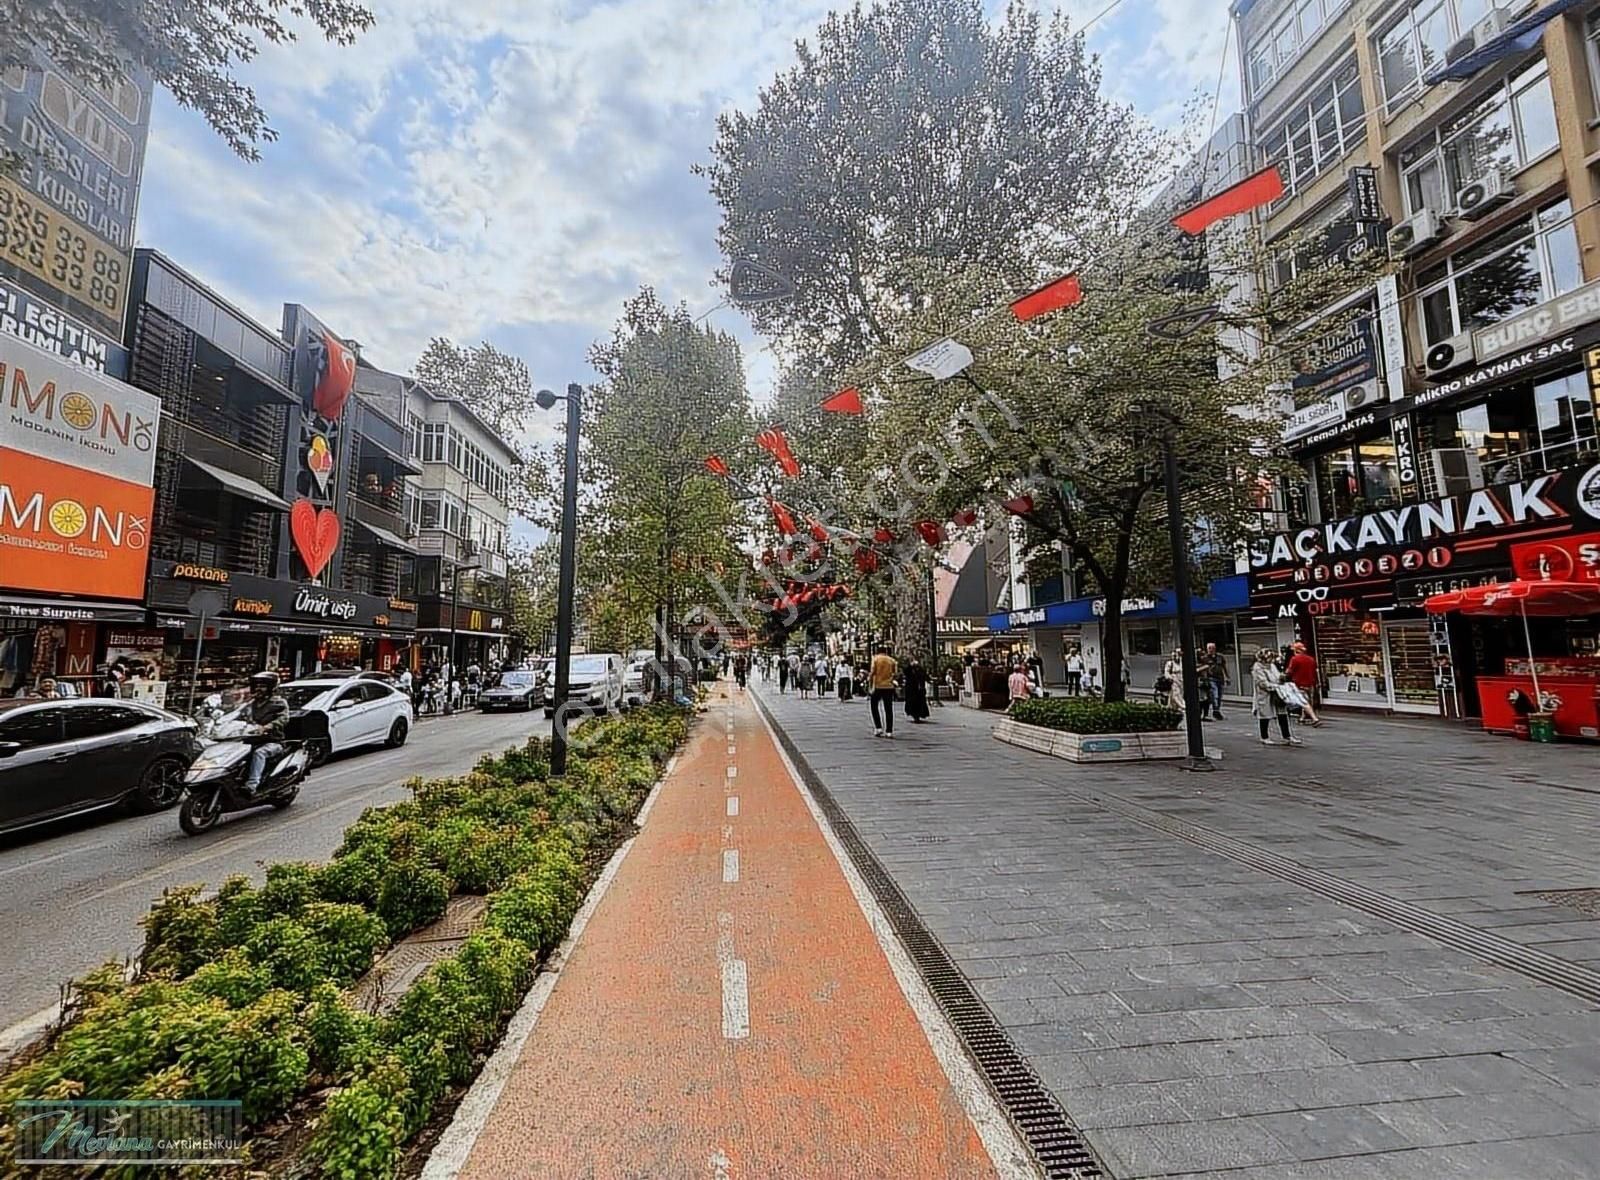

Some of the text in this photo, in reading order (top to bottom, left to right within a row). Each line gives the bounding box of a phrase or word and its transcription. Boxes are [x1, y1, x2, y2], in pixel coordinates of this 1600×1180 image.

[37, 170, 127, 248] KURSLARI
[56, 226, 87, 263] 33
[92, 249, 122, 285] 88
[52, 254, 83, 291] 33
[89, 276, 118, 311] 89
[25, 302, 107, 361] EĞİTİM
[1481, 315, 1553, 352] BURÇ
[1414, 337, 1575, 406] MİKRO KAYNAK SAÇ
[1307, 412, 1375, 445] Kemal AKTAŞ
[1394, 417, 1415, 482] MİKRO
[173, 563, 230, 583] postane
[1294, 546, 1449, 584] MERKEZİ
[10, 605, 40, 616] New
[295, 588, 329, 617] Ümit
[331, 601, 357, 620] usta
[1278, 603, 1299, 618] AK
